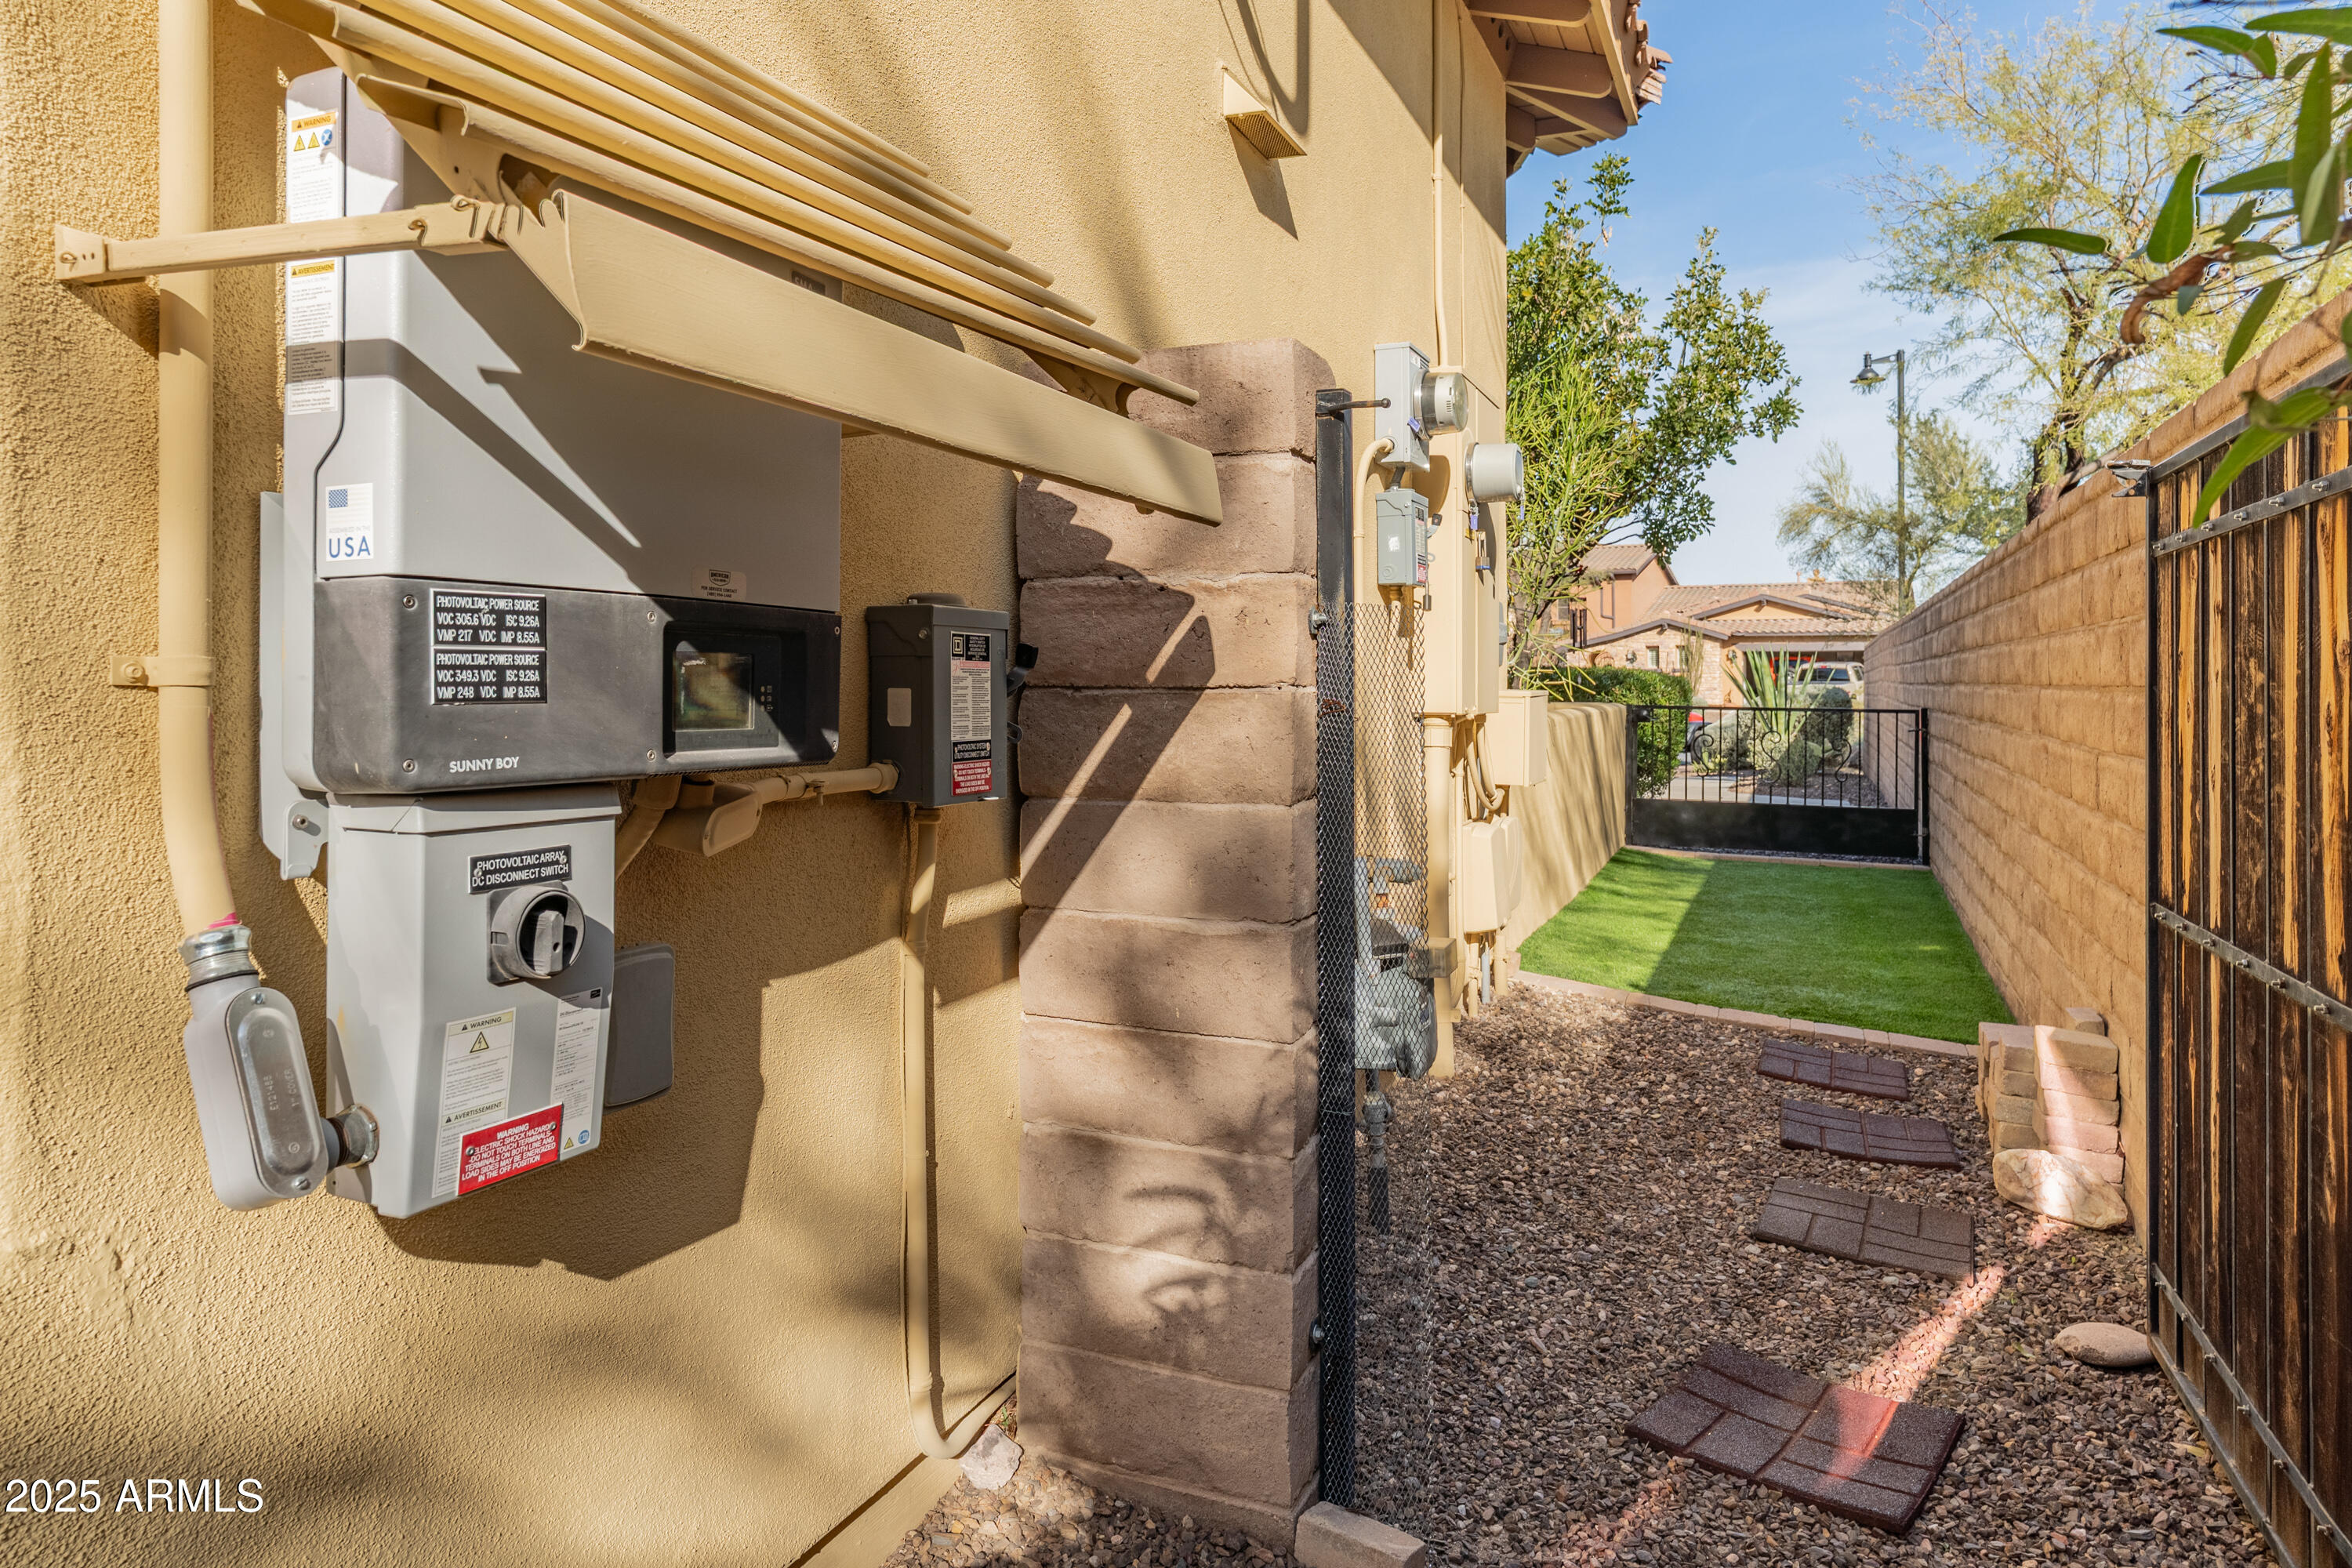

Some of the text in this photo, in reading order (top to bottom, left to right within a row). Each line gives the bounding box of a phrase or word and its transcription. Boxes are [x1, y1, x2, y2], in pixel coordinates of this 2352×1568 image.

[303, 115, 331, 126] WARNING
[328, 535, 371, 558] USA
[436, 596, 539, 611] PHOTOVOLTAIC POWER SOURCE
[437, 612, 539, 627] VOC 305.6 VDC ISC 9.26A
[437, 629, 539, 644] VMP 217 VDC IMP 8.55A
[436, 653, 539, 666] PHOTOVOLTAIC POWER SOURCE
[437, 670, 539, 682] VOC 349.3 VDC ISC 9.26A
[437, 686, 540, 699] VMP 248 VDC IMP 8.55A
[449, 757, 519, 773] SUNNY BOY
[477, 850, 564, 871] PHOTOVOLTAIC ARRAY
[472, 864, 569, 887] DC DISCONNECT SWITCH
[470, 1017, 502, 1029] WARNING
[453, 1102, 503, 1120] AVERTISSEMENT
[474, 1123, 550, 1155] ELECTRIC SHOCK HAZARD
[496, 1123, 529, 1140] WARNING
[465, 1135, 555, 1172] TERMINALS ON BOTH LINE AND
[481, 1149, 495, 1160] NOT
[495, 1142, 517, 1154] TOUCH
[461, 1142, 556, 1181] LOAD SIDES MAY BE ENERGIZED
[486, 1168, 499, 1179] THE
[499, 1163, 511, 1174] OFF
[512, 1154, 541, 1170] POSITION
